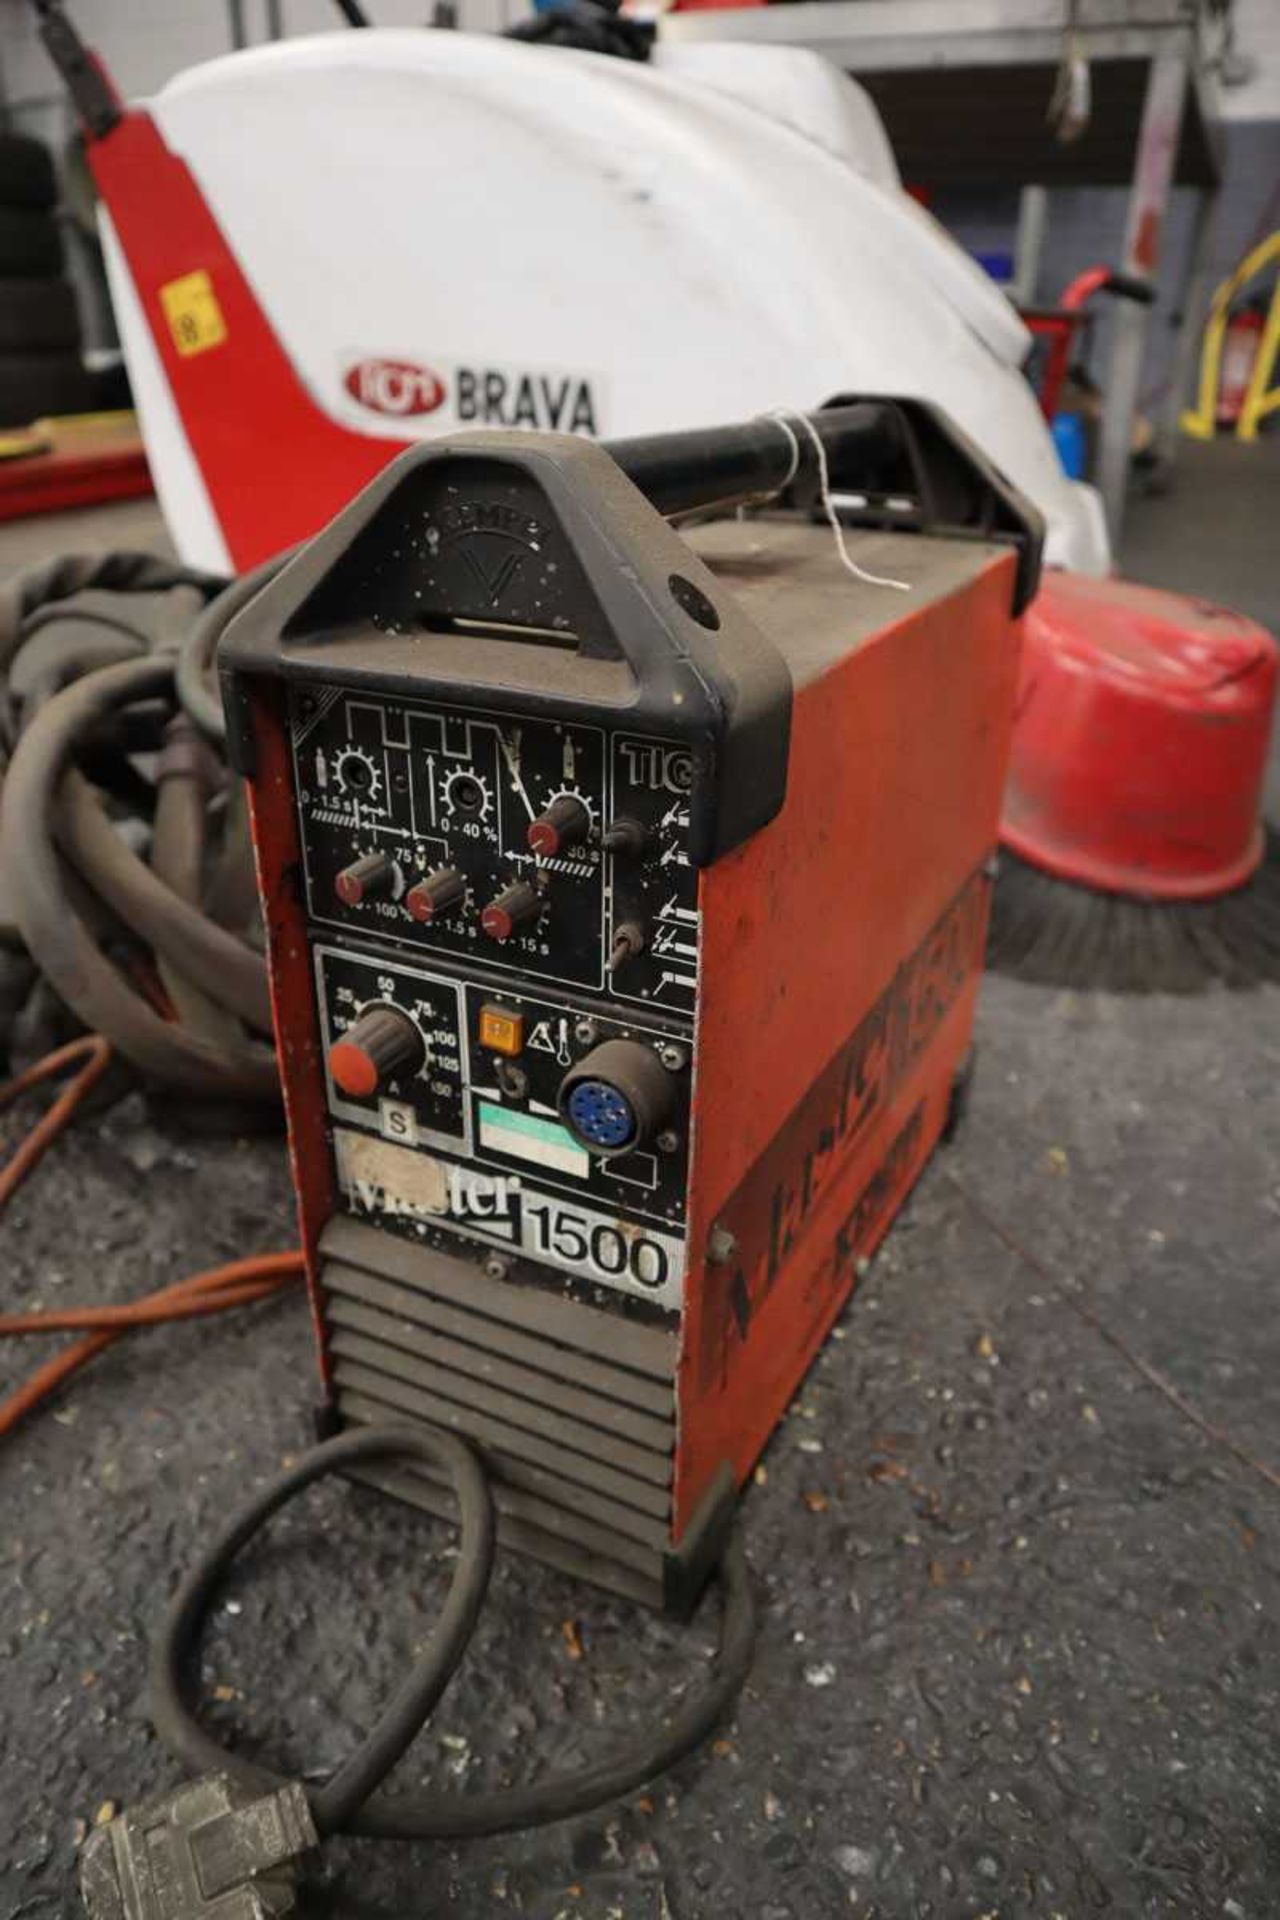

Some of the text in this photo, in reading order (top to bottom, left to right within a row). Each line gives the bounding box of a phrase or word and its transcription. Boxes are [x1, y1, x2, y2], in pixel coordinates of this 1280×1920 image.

[457, 367, 597, 434] BRAVA
[619, 742, 693, 796] TIG
[441, 817, 450, 832] 0
[463, 822, 480, 838] 40
[482, 825, 498, 842] %
[394, 847, 413, 863] 75
[375, 901, 398, 919] 100
[445, 918, 465, 935] 1.5
[520, 936, 537, 952] 15
[377, 975, 395, 992] 50
[336, 986, 354, 1003] 25
[414, 999, 433, 1017] 75
[433, 1029, 456, 1047] 100
[437, 1055, 459, 1073] 125
[389, 1111, 407, 1136] S
[347, 1163, 669, 1289] Mter 1500
